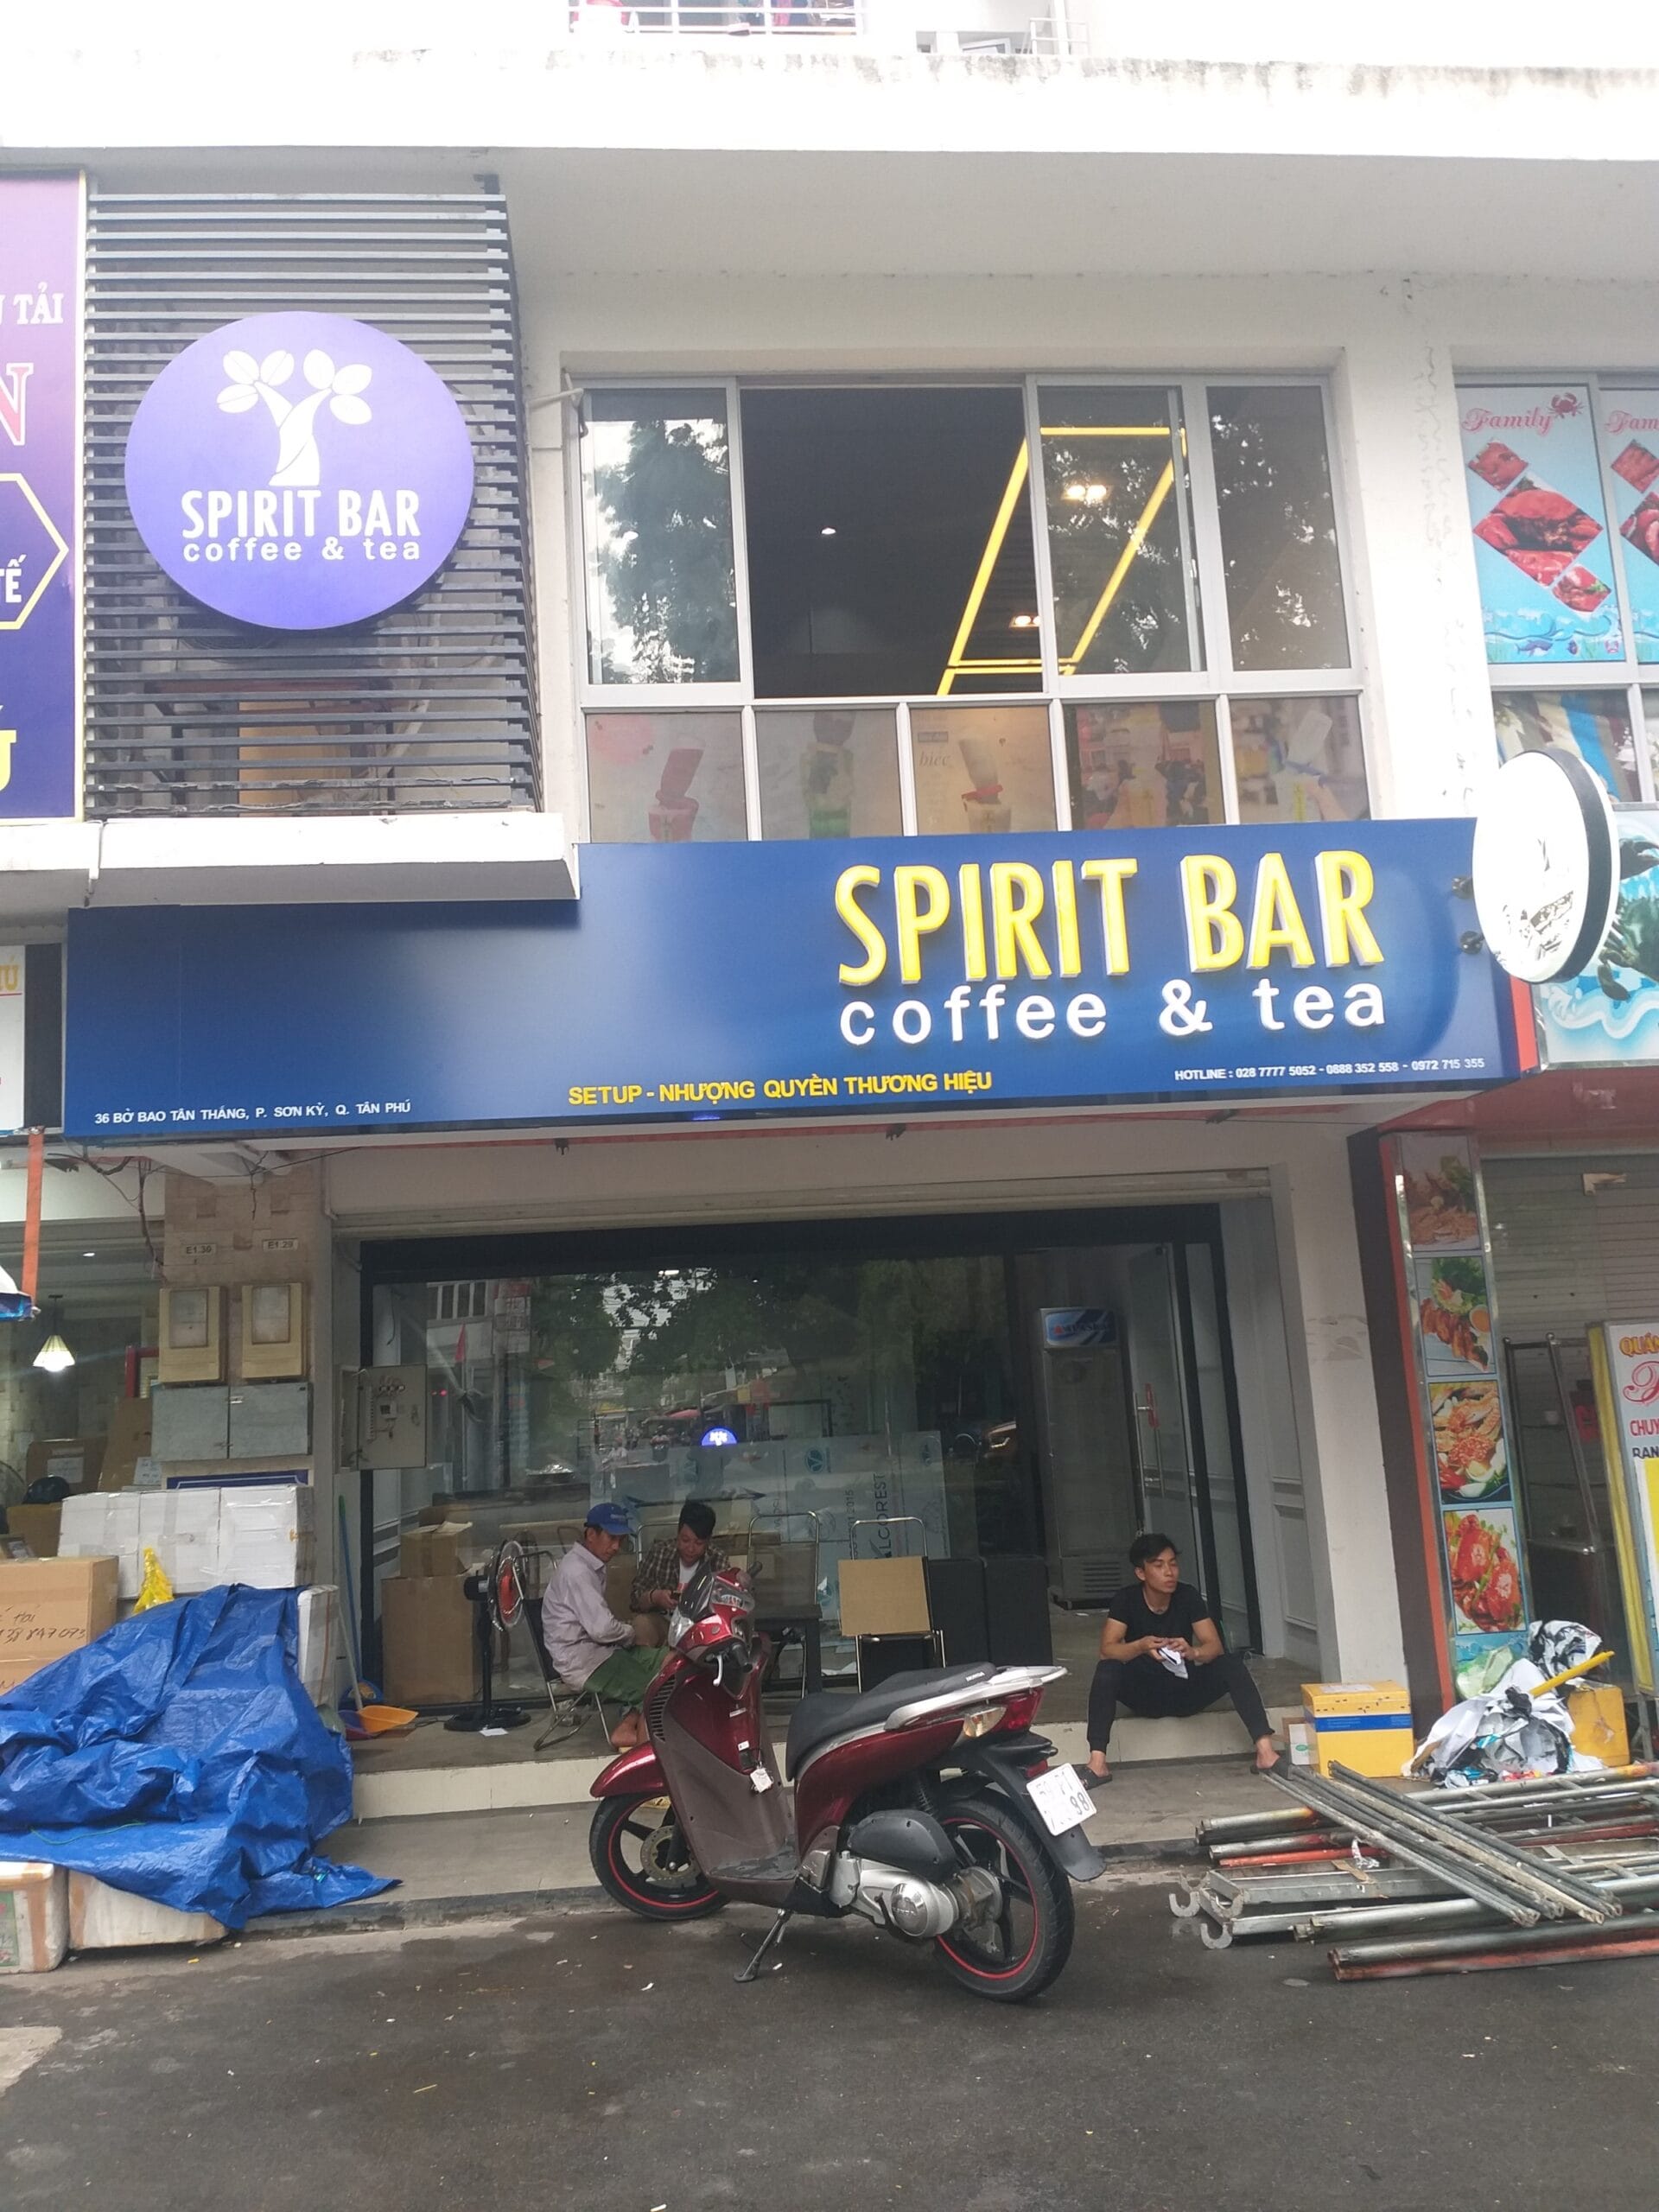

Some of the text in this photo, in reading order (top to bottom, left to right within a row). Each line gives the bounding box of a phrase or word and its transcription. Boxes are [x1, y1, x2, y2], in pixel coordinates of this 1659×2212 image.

[12, 282, 65, 325] TẢI
[1461, 406, 1554, 435] Family
[181, 489, 421, 538] SPIRIT BAR
[183, 536, 420, 562] coffee & tea
[0, 554, 27, 602] Ế
[835, 857, 1137, 986] SPIRIT
[1179, 850, 1384, 973] BAR
[839, 978, 1385, 1045] coffee & tea
[568, 1084, 642, 1105] SETUP
[659, 1081, 755, 1105] NHƯỢNG
[763, 1073, 838, 1099] QUYỀN
[843, 1072, 938, 1095] THƯƠNG
[944, 1069, 992, 1095] HIỆU
[1174, 1068, 1227, 1081] HOTLINE
[1236, 1067, 1256, 1078] 028
[1258, 1066, 1286, 1077] 7777
[1288, 1065, 1317, 1077] 5052
[1325, 1063, 1353, 1075] 0888
[1354, 1062, 1376, 1074] 352
[1378, 1061, 1399, 1072] 558
[1411, 1059, 1440, 1071] 0972
[1441, 1058, 1461, 1070] 715
[1464, 1058, 1484, 1069] 355
[94, 1113, 110, 1124] 36
[137, 1111, 166, 1122] BAO
[169, 1108, 195, 1122] TÂN
[255, 1107, 268, 1118] P.
[273, 1105, 302, 1117] SƠN
[335, 1104, 350, 1116] Q.
[355, 1101, 380, 1115] TÂN
[385, 1098, 411, 1114] PHÚ
